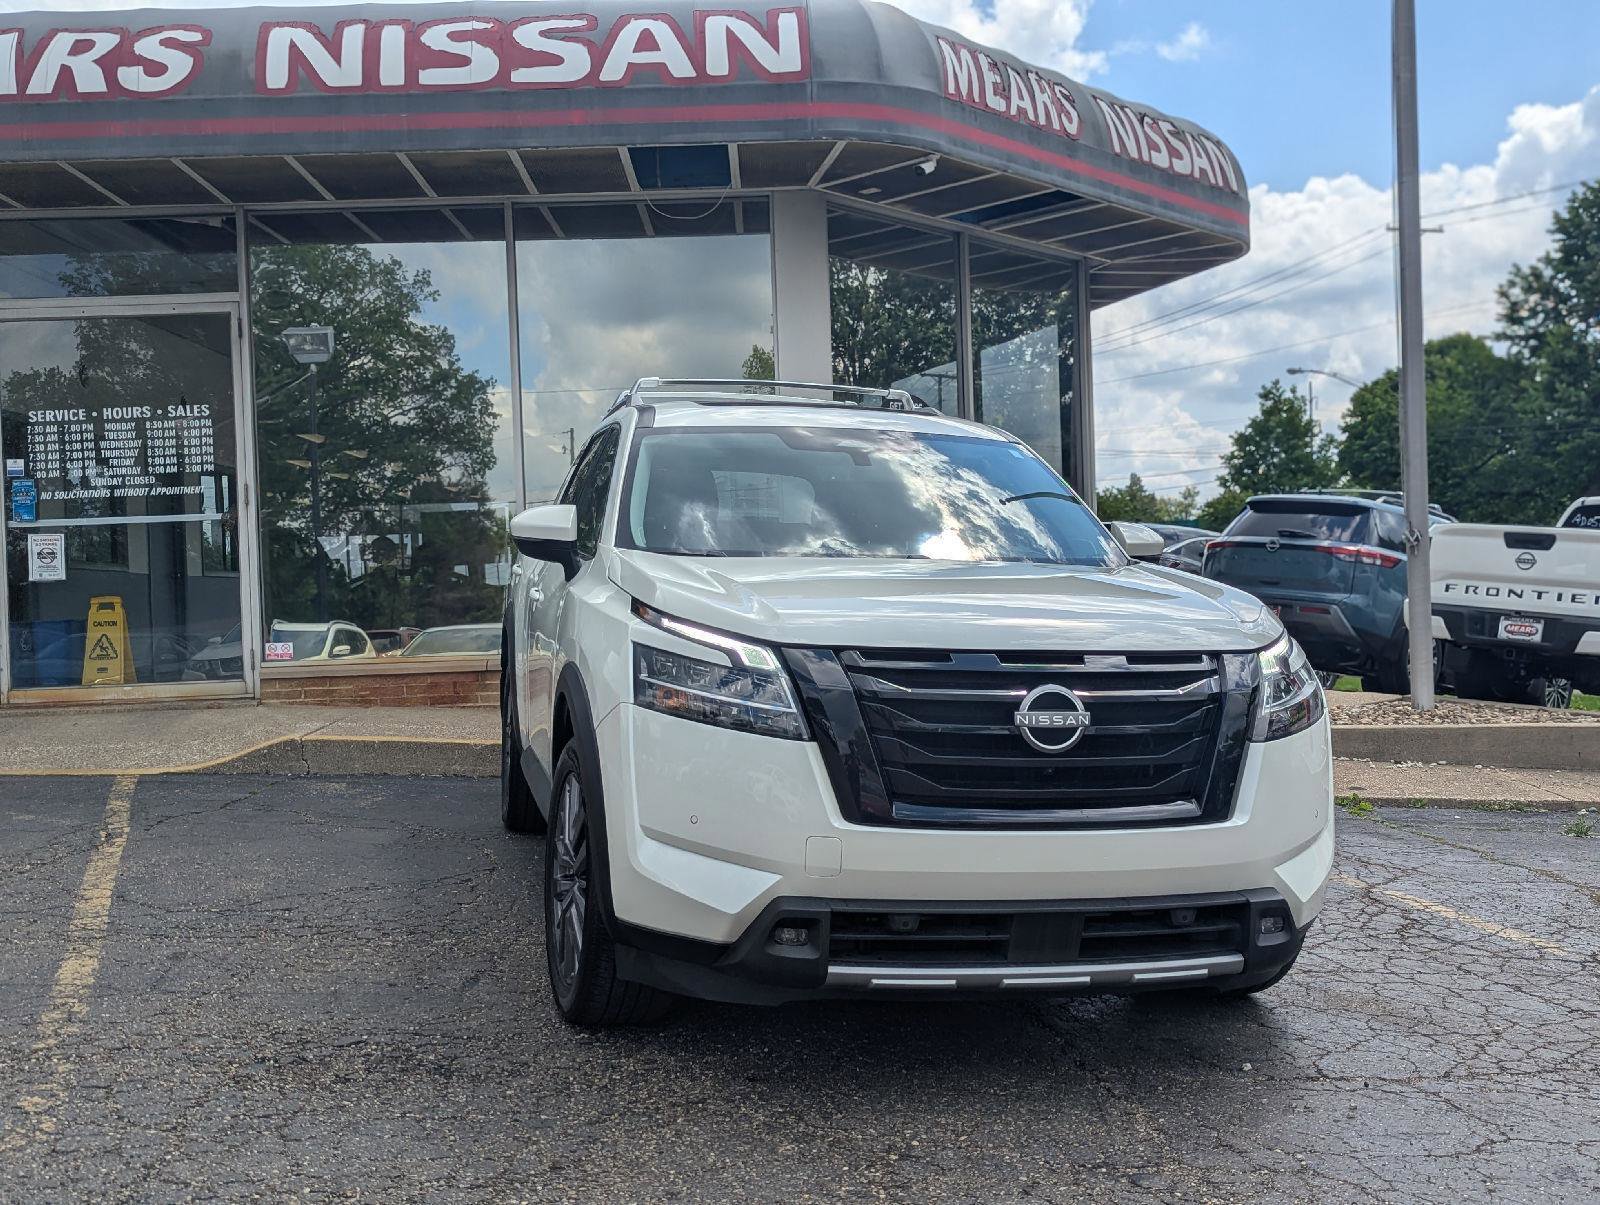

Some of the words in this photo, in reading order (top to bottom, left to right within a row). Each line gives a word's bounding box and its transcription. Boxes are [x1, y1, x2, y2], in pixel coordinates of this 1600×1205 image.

[0, 28, 202, 95] RS
[265, 12, 804, 90] NISSAN
[938, 38, 1081, 136] MEARS
[1095, 96, 1238, 192] NISSAN
[28, 408, 87, 423] SERVICE
[102, 405, 151, 420] HOURS
[167, 404, 210, 417] SALES
[27, 425, 44, 434] 7:30
[46, 425, 58, 433] AM
[82, 423, 94, 431] PM
[104, 422, 136, 430] MONDAY
[145, 421, 162, 429] 8:30
[163, 420, 175, 428] AM
[182, 419, 200, 427] 8:00
[200, 419, 212, 427] PM
[27, 434, 44, 443] 7:30
[46, 433, 58, 441] AM
[64, 433, 81, 441] 6:00
[82, 432, 94, 440] PM
[104, 431, 136, 440] TUESDAY
[146, 429, 163, 438] 9:00
[164, 429, 176, 438] AM
[201, 428, 213, 436] PM
[28, 444, 45, 452] 7:30
[47, 443, 59, 451] AM
[65, 442, 82, 451] 6:00
[83, 441, 95, 450] PM
[99, 439, 142, 449] WEDNESDAY
[147, 439, 163, 447] 9:00
[164, 438, 176, 446] AM
[184, 438, 200, 446] 6:00
[201, 437, 213, 445] PM
[29, 453, 46, 461] 7:30
[48, 452, 60, 460] AM
[66, 452, 82, 460] 7:00
[84, 450, 96, 459] PM
[101, 448, 139, 458] THURSDAY
[147, 448, 163, 456] 8:30
[164, 447, 176, 455] AM
[184, 447, 201, 455] 8:00
[202, 446, 214, 454] PM
[29, 462, 46, 470] 7:30
[48, 461, 60, 469] AM
[84, 459, 96, 467] PM
[109, 457, 135, 466] FRIDAY
[147, 457, 164, 465] 9:00
[165, 456, 177, 465] AM
[202, 455, 214, 463] PM
[48, 470, 60, 478] AM
[85, 468, 97, 477] PM
[103, 466, 141, 476] SATURDAY
[148, 466, 164, 474] 9:00
[166, 465, 178, 474] AM
[203, 464, 214, 472] PM
[91, 477, 122, 486] SUNDAY
[125, 475, 155, 485] CLOSED
[40, 491, 52, 500] NO
[53, 488, 111, 500] SOLICITATIONS
[114, 487, 150, 497] WITHOUT
[150, 485, 204, 496] APPOINTMENT
[1505, 625, 1537, 634] MEARS
[1017, 715, 1089, 725] NISSAN
